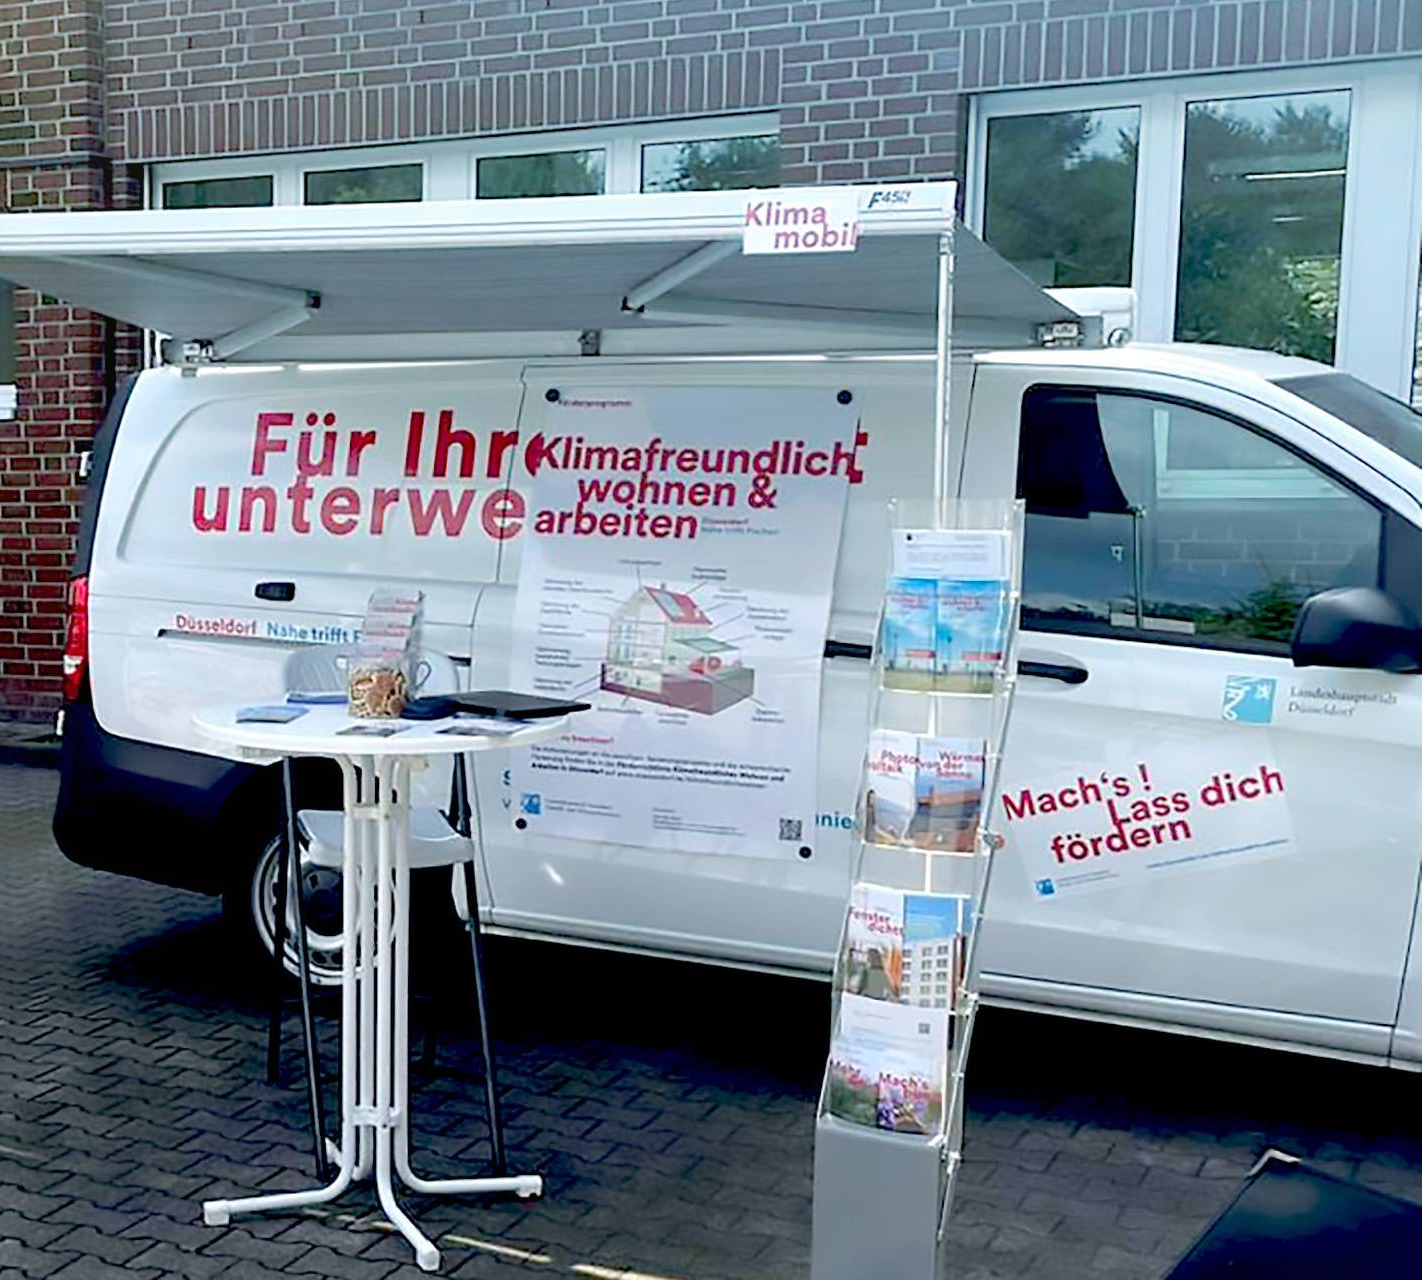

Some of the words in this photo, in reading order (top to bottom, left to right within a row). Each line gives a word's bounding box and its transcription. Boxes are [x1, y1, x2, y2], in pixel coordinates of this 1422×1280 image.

[745, 202, 826, 227] Klima
[774, 222, 859, 249] mobil
[250, 412, 376, 477] Für
[537, 436, 854, 476] Klimafreundlich
[192, 475, 526, 539] unterwe
[577, 473, 737, 507] wohnen
[747, 472, 777, 508] &
[534, 502, 698, 539] arbeiten
[312, 629, 349, 643] trifft
[1108, 791, 1190, 824] Lass
[1200, 765, 1284, 807] dich
[1050, 820, 1192, 864] fördern
